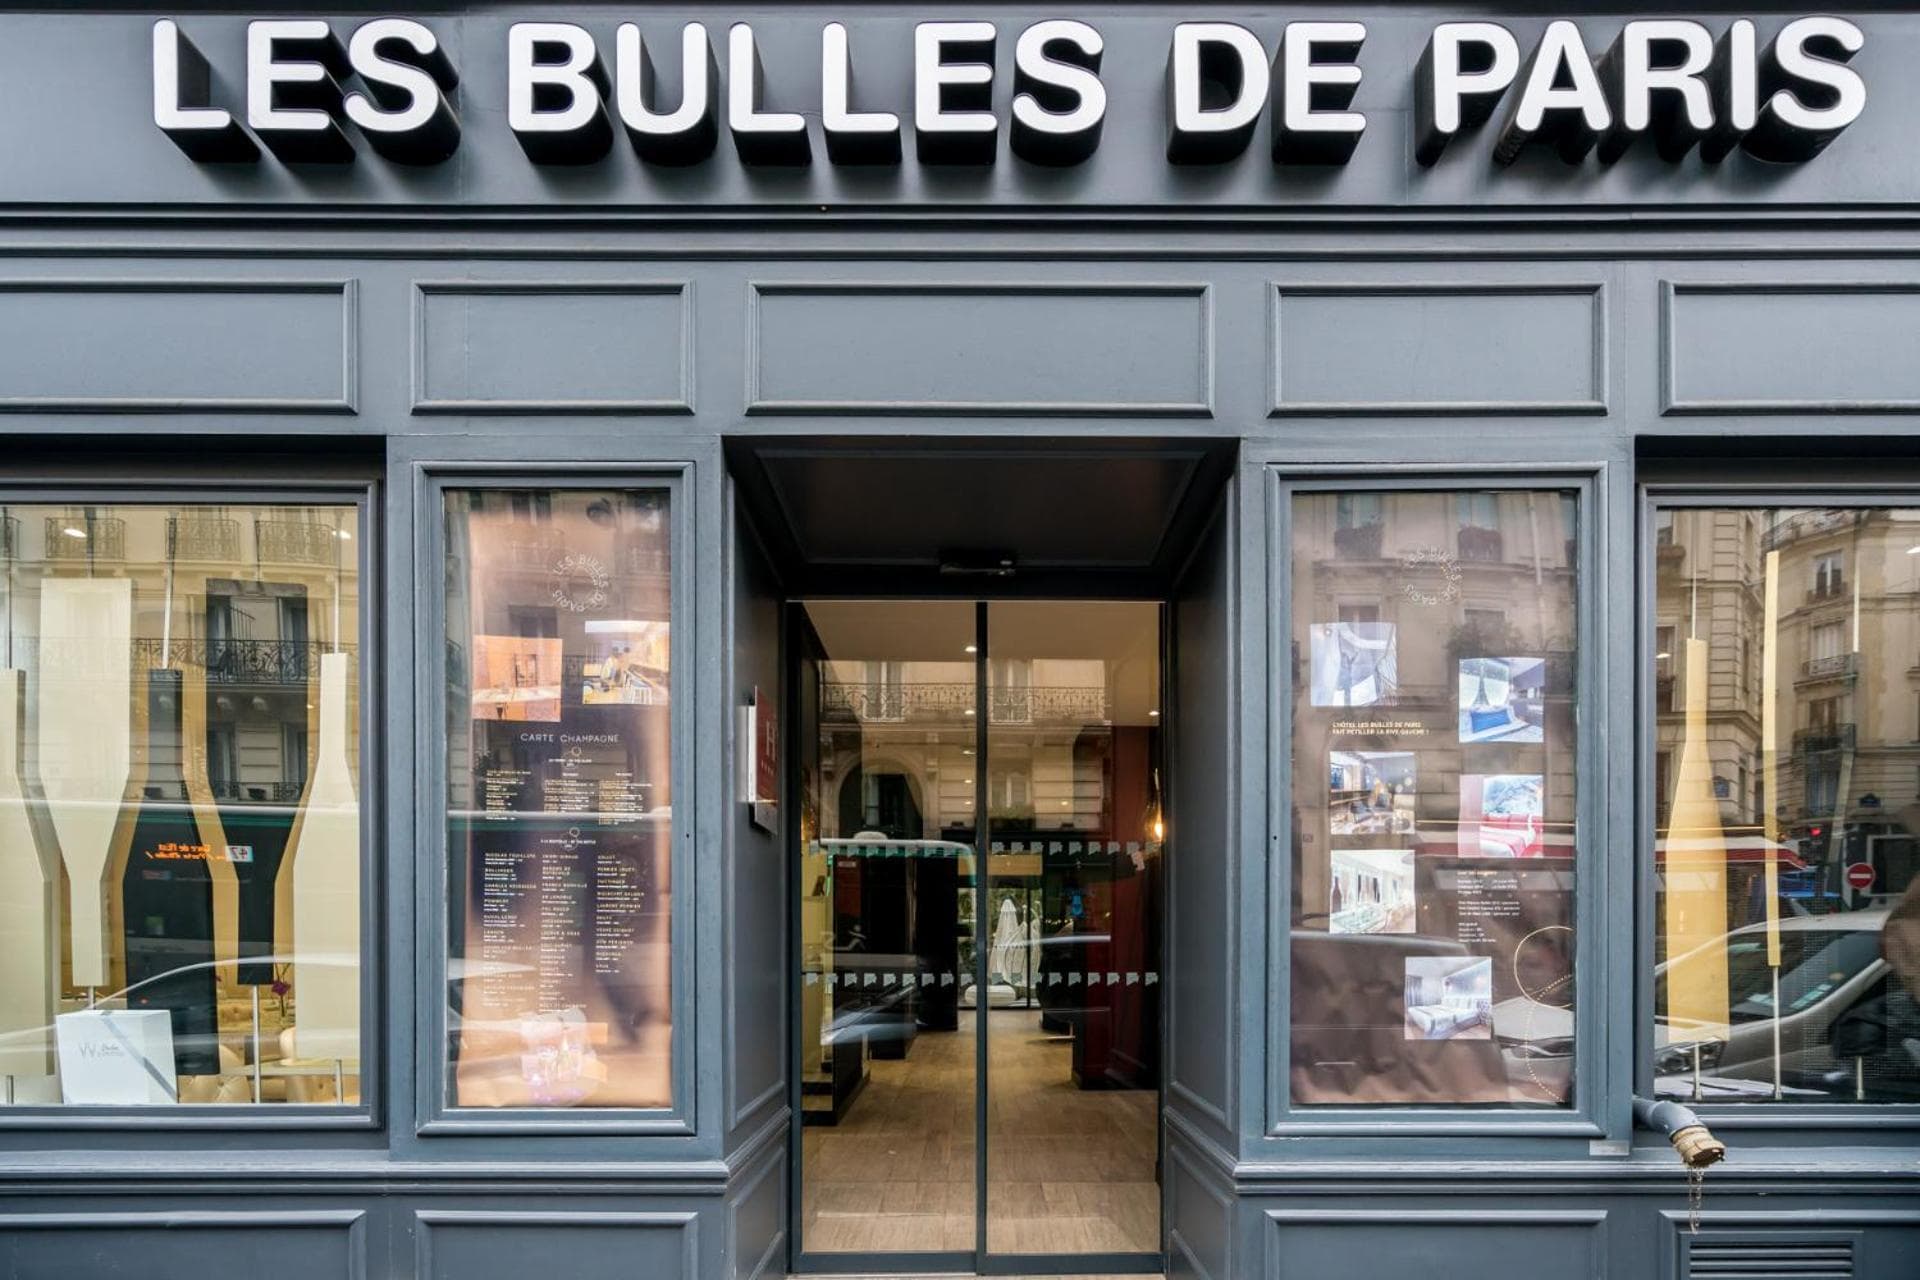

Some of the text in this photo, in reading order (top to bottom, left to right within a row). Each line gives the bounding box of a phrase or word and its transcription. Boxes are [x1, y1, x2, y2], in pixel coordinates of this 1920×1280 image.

[152, 17, 1867, 134] LES BULLES DE PARIS
[553, 555, 574, 576] LES
[520, 732, 620, 744] CARTE CHAMPAGNE
[765, 719, 776, 763] H
